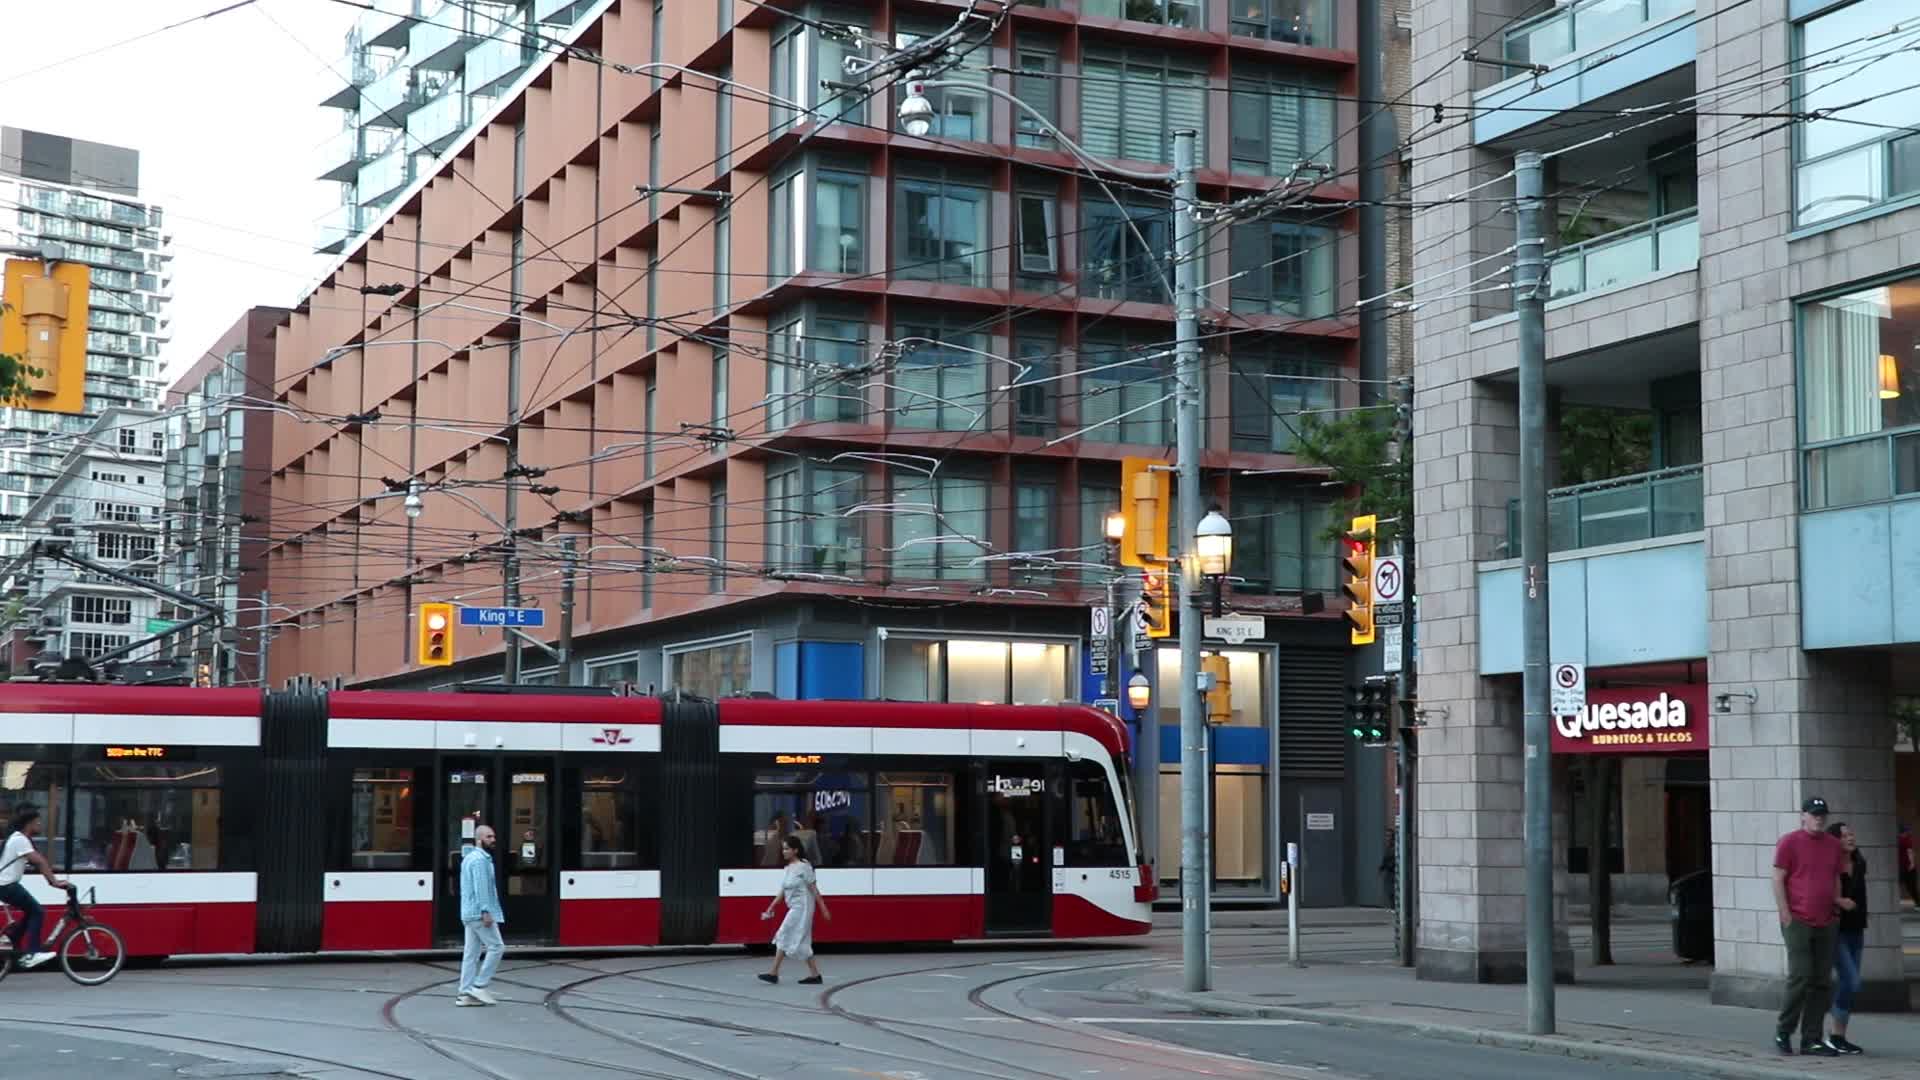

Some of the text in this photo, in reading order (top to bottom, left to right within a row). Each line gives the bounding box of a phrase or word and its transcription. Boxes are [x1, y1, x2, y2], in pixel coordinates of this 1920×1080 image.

[479, 609, 505, 625] King
[517, 611, 525, 622] E
[1216, 627, 1232, 636] KING
[1555, 692, 1686, 738] Quesada
[1592, 731, 1693, 745] BURRITOS & TACOS
[1109, 869, 1131, 880] 4515
